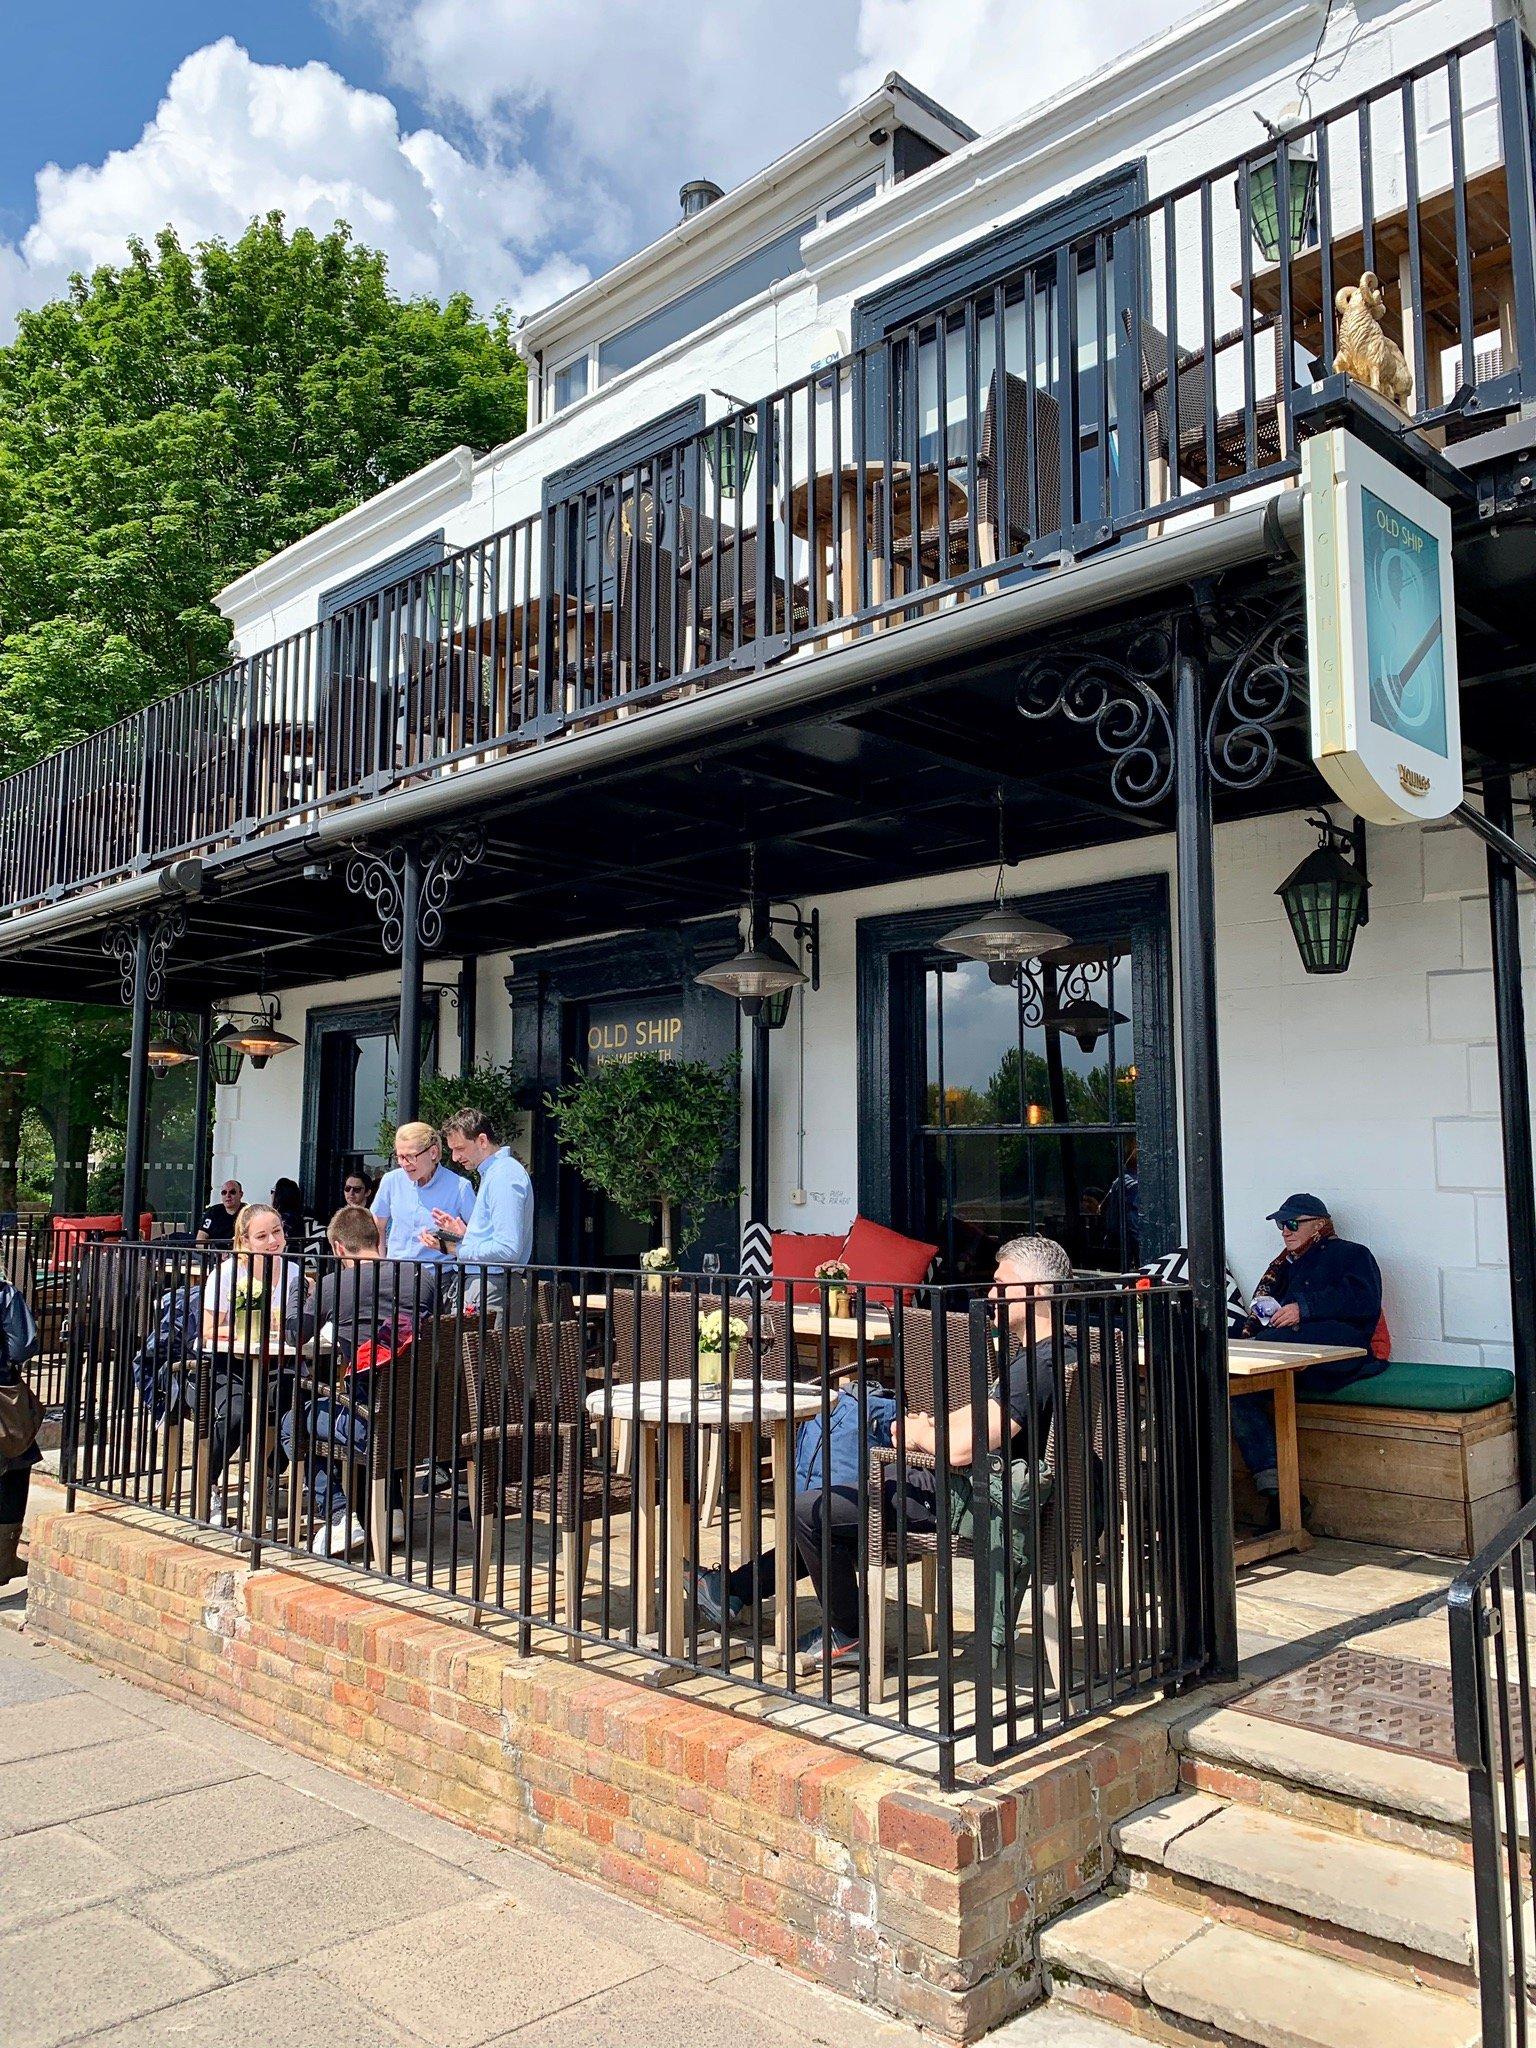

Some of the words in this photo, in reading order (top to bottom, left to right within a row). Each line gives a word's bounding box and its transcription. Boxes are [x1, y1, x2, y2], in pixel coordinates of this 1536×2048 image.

[1376, 509, 1399, 538] OLD
[1401, 526, 1424, 553] SHIP
[587, 1023, 628, 1050] OLD
[635, 1017, 682, 1046] SHIP
